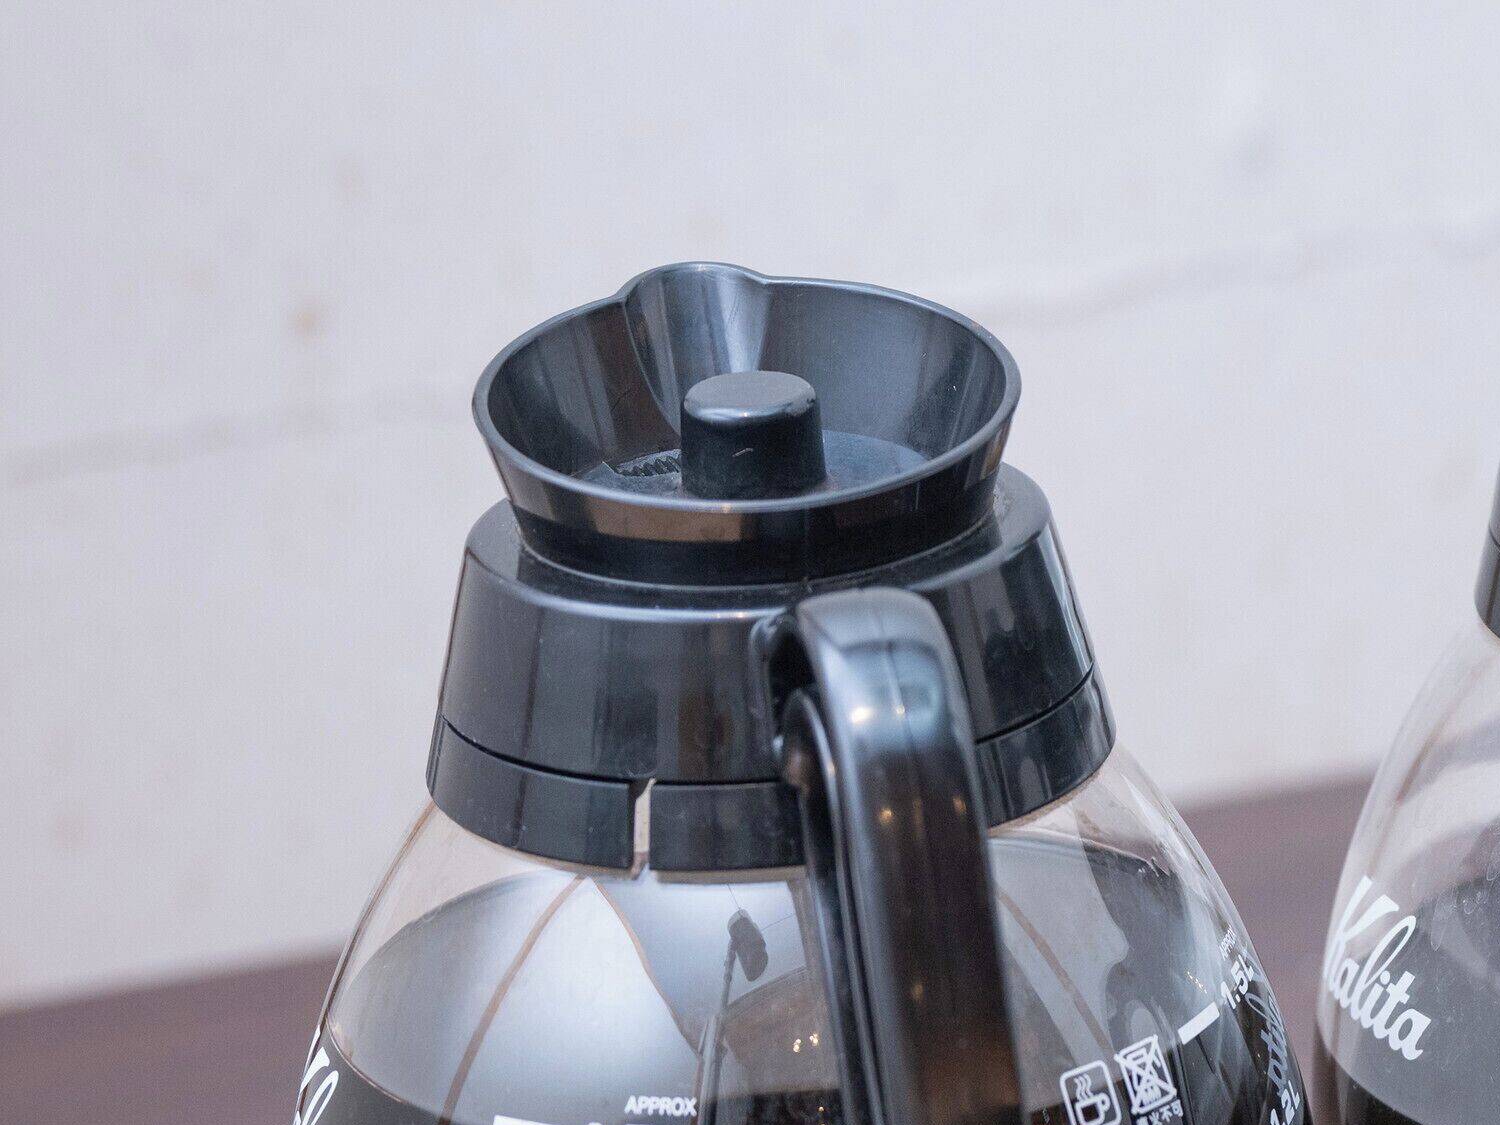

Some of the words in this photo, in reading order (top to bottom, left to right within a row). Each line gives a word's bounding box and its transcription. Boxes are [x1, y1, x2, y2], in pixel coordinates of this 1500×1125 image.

[1220, 953, 1255, 1010] 1.5L
[1323, 875, 1432, 1061] Kalita
[624, 1095, 698, 1117] APPROX
